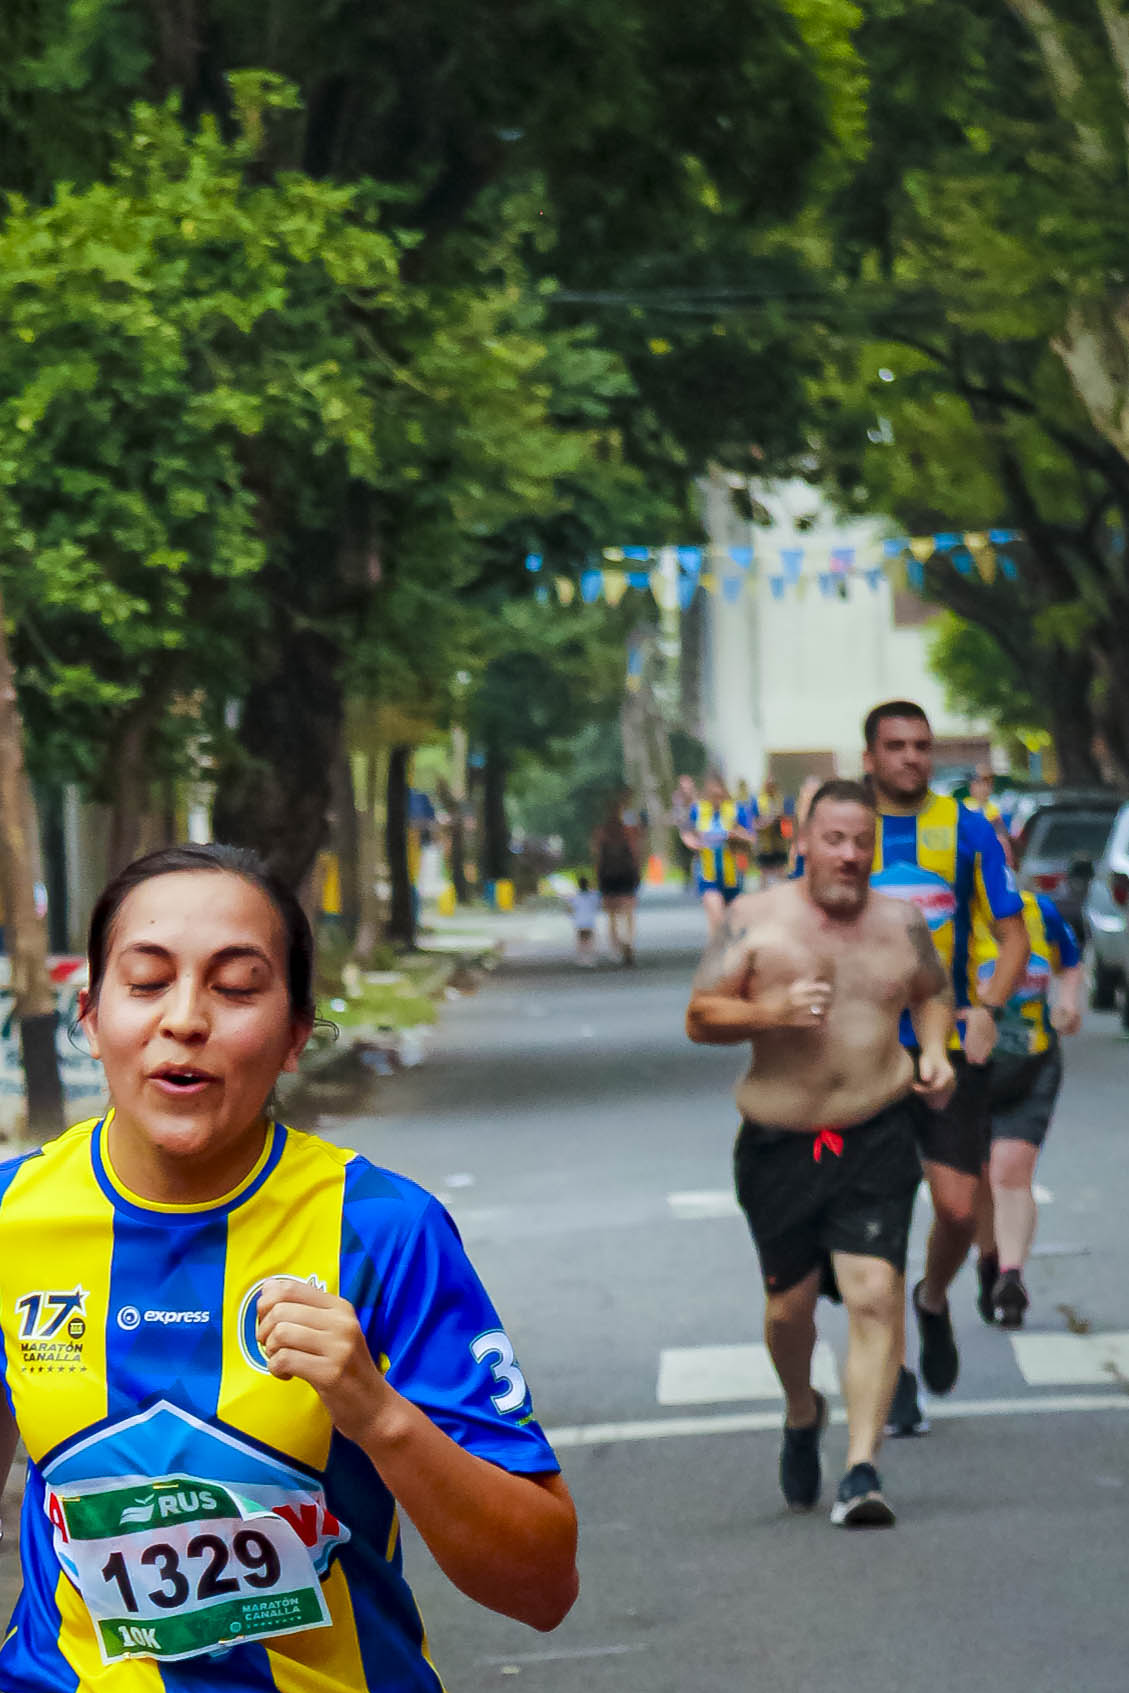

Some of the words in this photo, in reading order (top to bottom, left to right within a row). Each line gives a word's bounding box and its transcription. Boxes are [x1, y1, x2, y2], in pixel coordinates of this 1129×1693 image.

[16, 1287, 89, 1340] 17
[143, 1310, 210, 1325] express
[21, 1341, 83, 1353] MARATÓN
[23, 1352, 81, 1362] CANALLA
[158, 1491, 217, 1517] RUS
[101, 1529, 281, 1613] 1329
[245, 1605, 301, 1620] CANALLA
[118, 1625, 162, 1650] 10K
